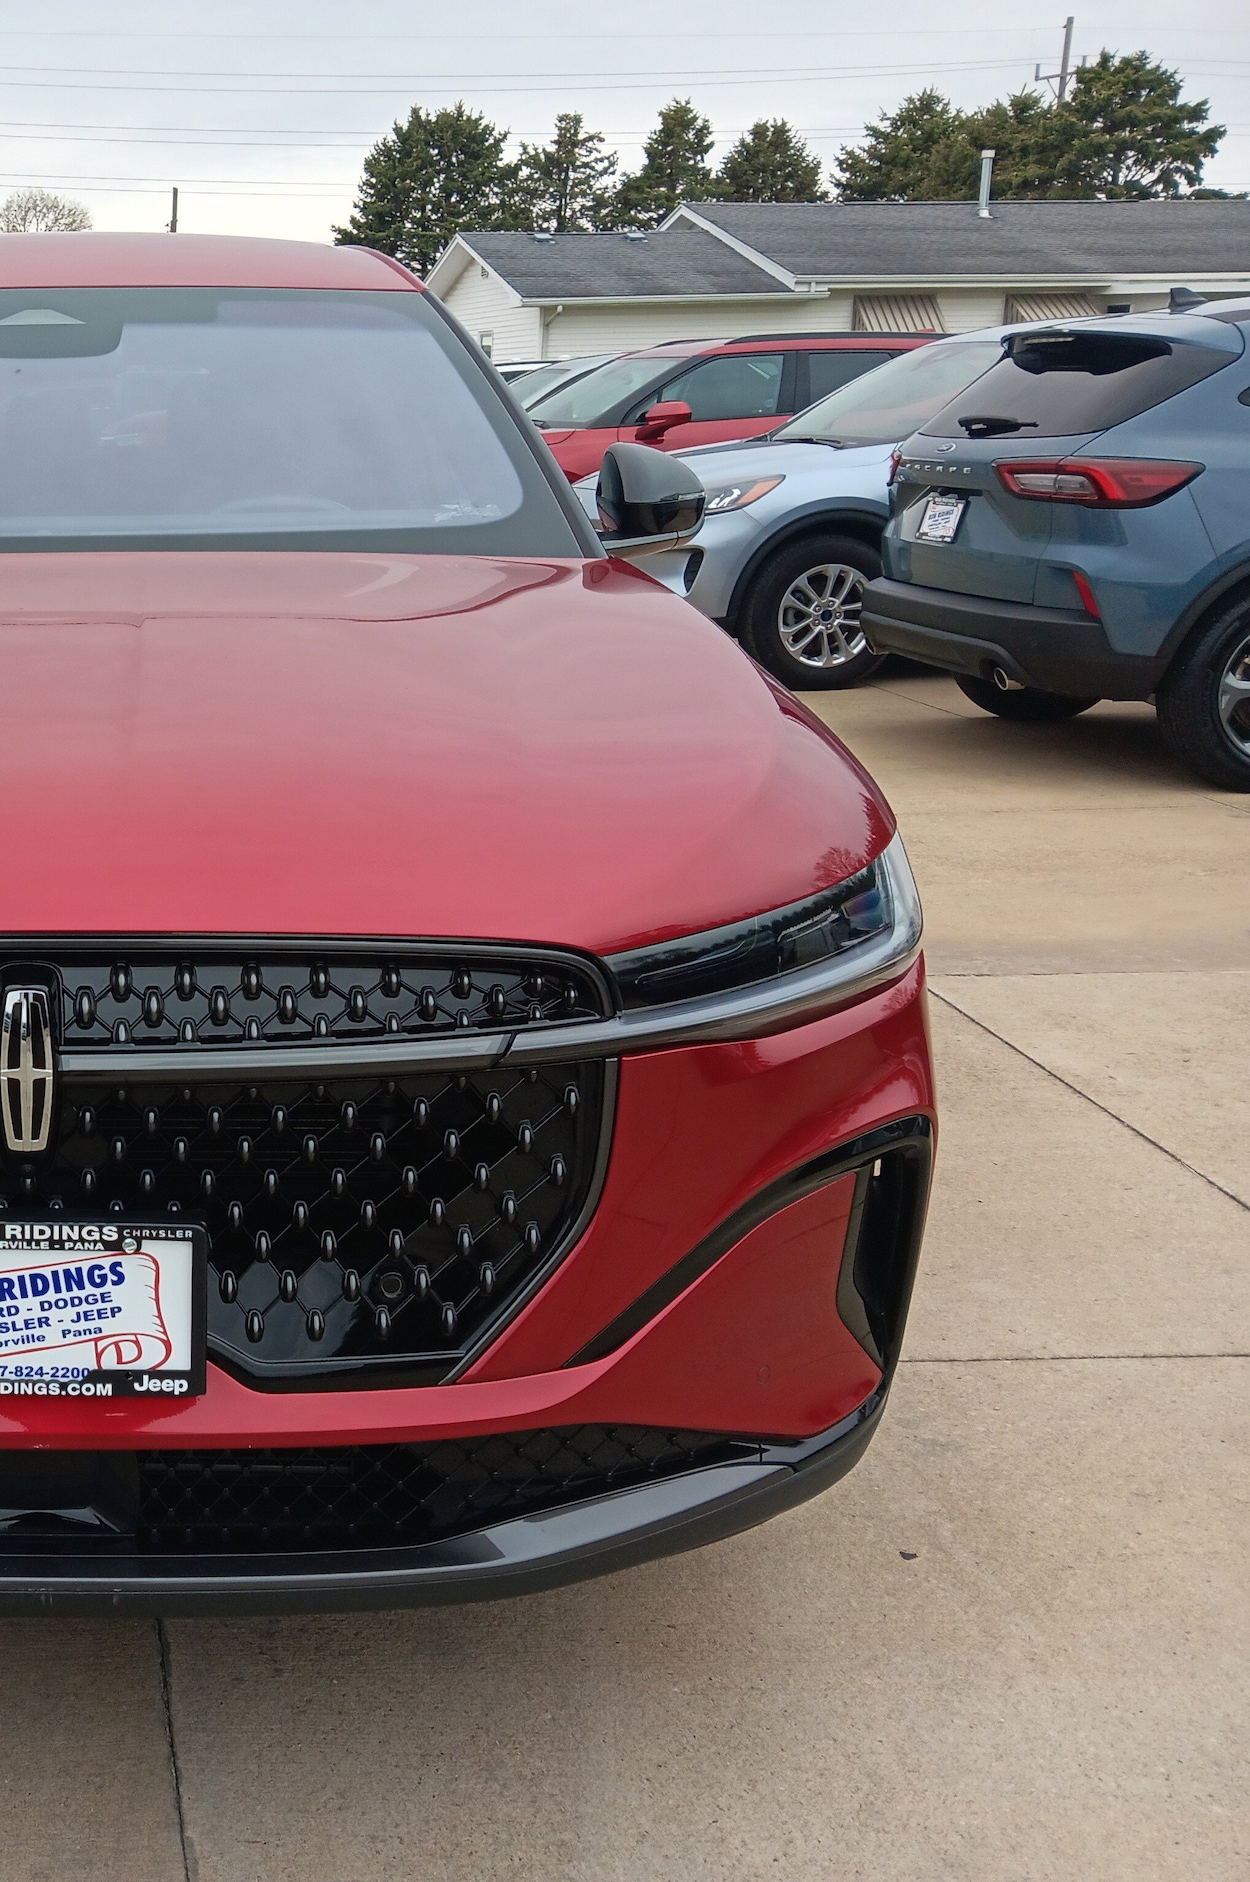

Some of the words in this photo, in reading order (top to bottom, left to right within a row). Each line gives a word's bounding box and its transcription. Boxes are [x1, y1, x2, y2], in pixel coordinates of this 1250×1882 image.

[5, 1224, 119, 1241] RIDINGS
[123, 1229, 193, 1239] CHRYSLER
[64, 1242, 105, 1250] PANA
[39, 1291, 113, 1312] DODGE
[70, 1306, 123, 1324] JEEP
[61, 1326, 103, 1339] Pana
[133, 1375, 189, 1395] Jeep
